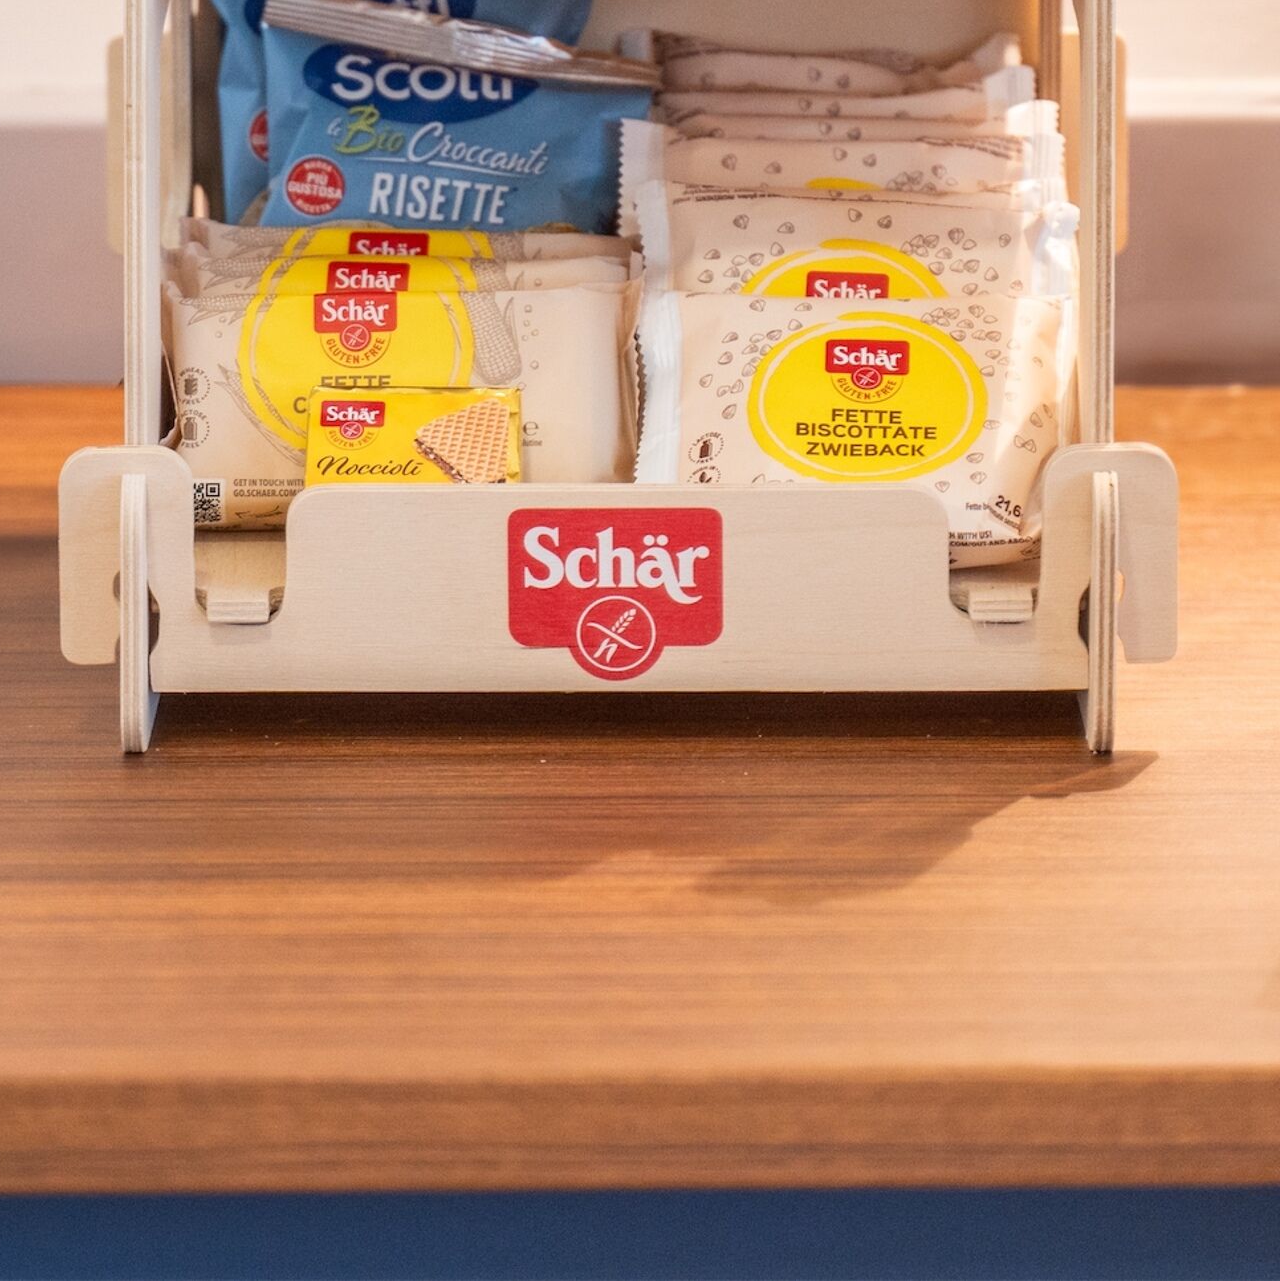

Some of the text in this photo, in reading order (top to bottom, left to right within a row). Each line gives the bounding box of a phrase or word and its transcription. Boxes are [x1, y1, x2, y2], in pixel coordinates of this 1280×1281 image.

[332, 104, 405, 155] Bio
[407, 121, 550, 175] Croccanti
[287, 180, 343, 200] GUSTOSA
[369, 172, 510, 224] RISETTE
[334, 267, 402, 292] Schär
[322, 298, 389, 327] Schär
[326, 337, 385, 364] GLUTEN-FREE
[833, 345, 903, 372] Schär
[837, 377, 897, 400] GLUTEN-FREE
[326, 405, 379, 425] Schär
[831, 408, 902, 425] FETTE
[796, 422, 937, 440] BISCOTTATE
[806, 441, 925, 457] ZWIEBACK
[317, 455, 424, 476] Noccioli
[995, 494, 1022, 518] 21,6
[523, 526, 711, 604] Schär
